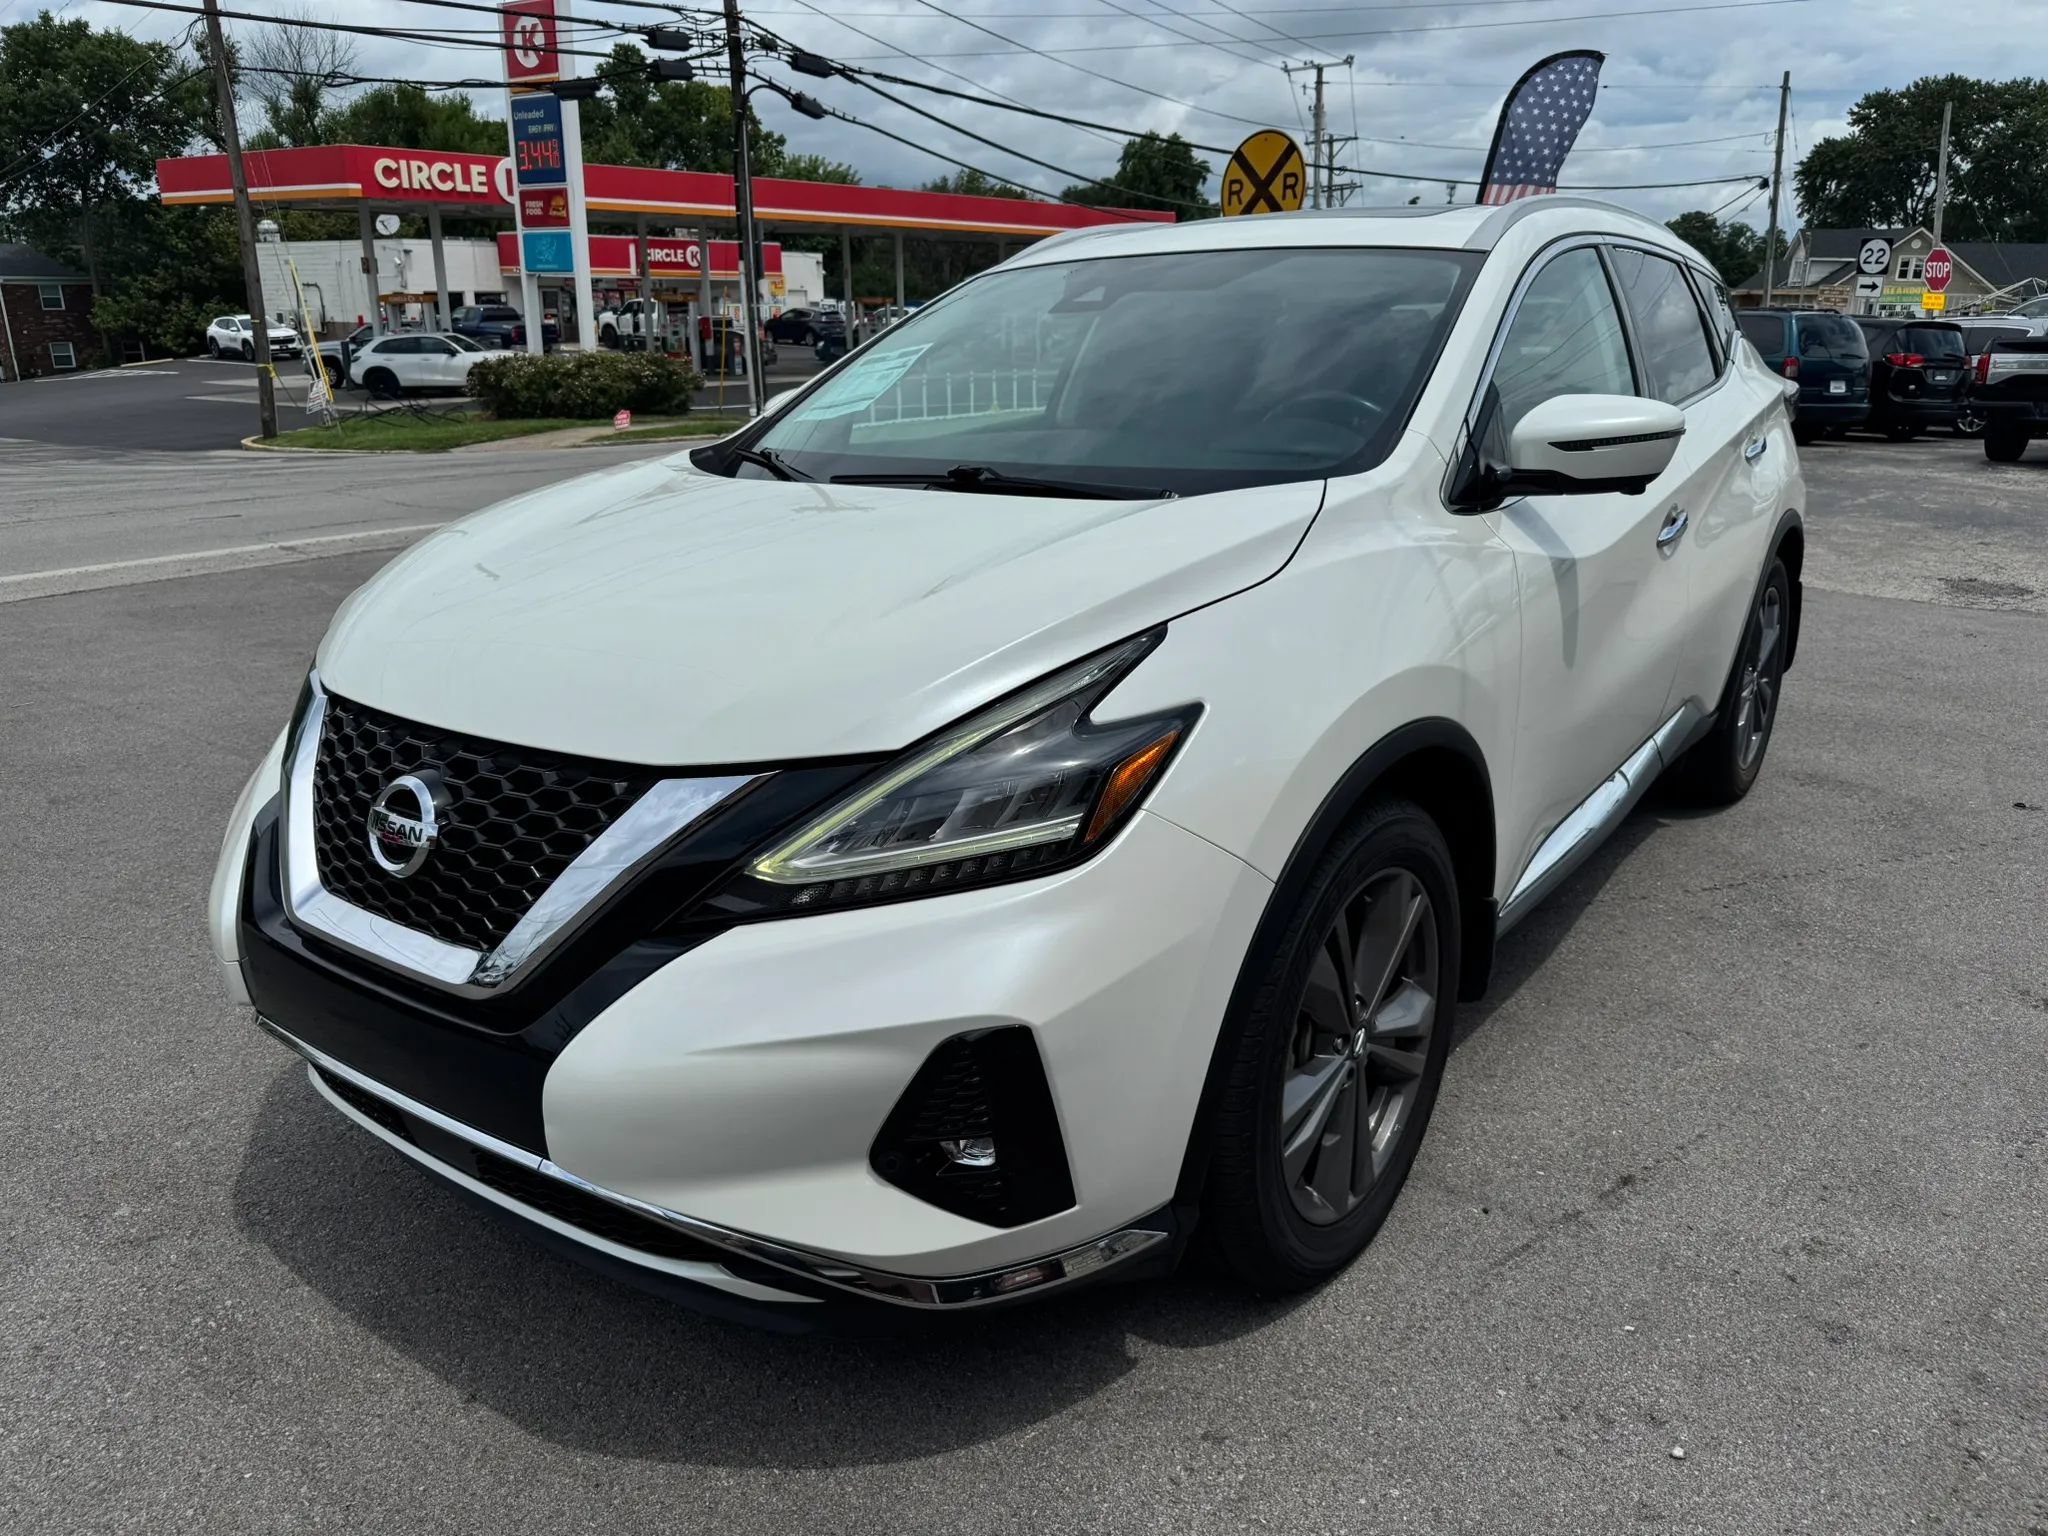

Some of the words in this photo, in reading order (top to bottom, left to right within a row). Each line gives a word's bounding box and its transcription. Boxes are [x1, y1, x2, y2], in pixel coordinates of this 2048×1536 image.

[519, 21, 544, 63] K
[513, 109, 544, 120] Unleaded
[374, 158, 489, 193] CIRCLE
[1227, 179, 1244, 207] R
[1282, 172, 1299, 201] R
[525, 200, 544, 208] FRESH
[1863, 248, 1886, 264] 22
[1926, 261, 1951, 278] STOP
[368, 811, 423, 842] NISSAN
